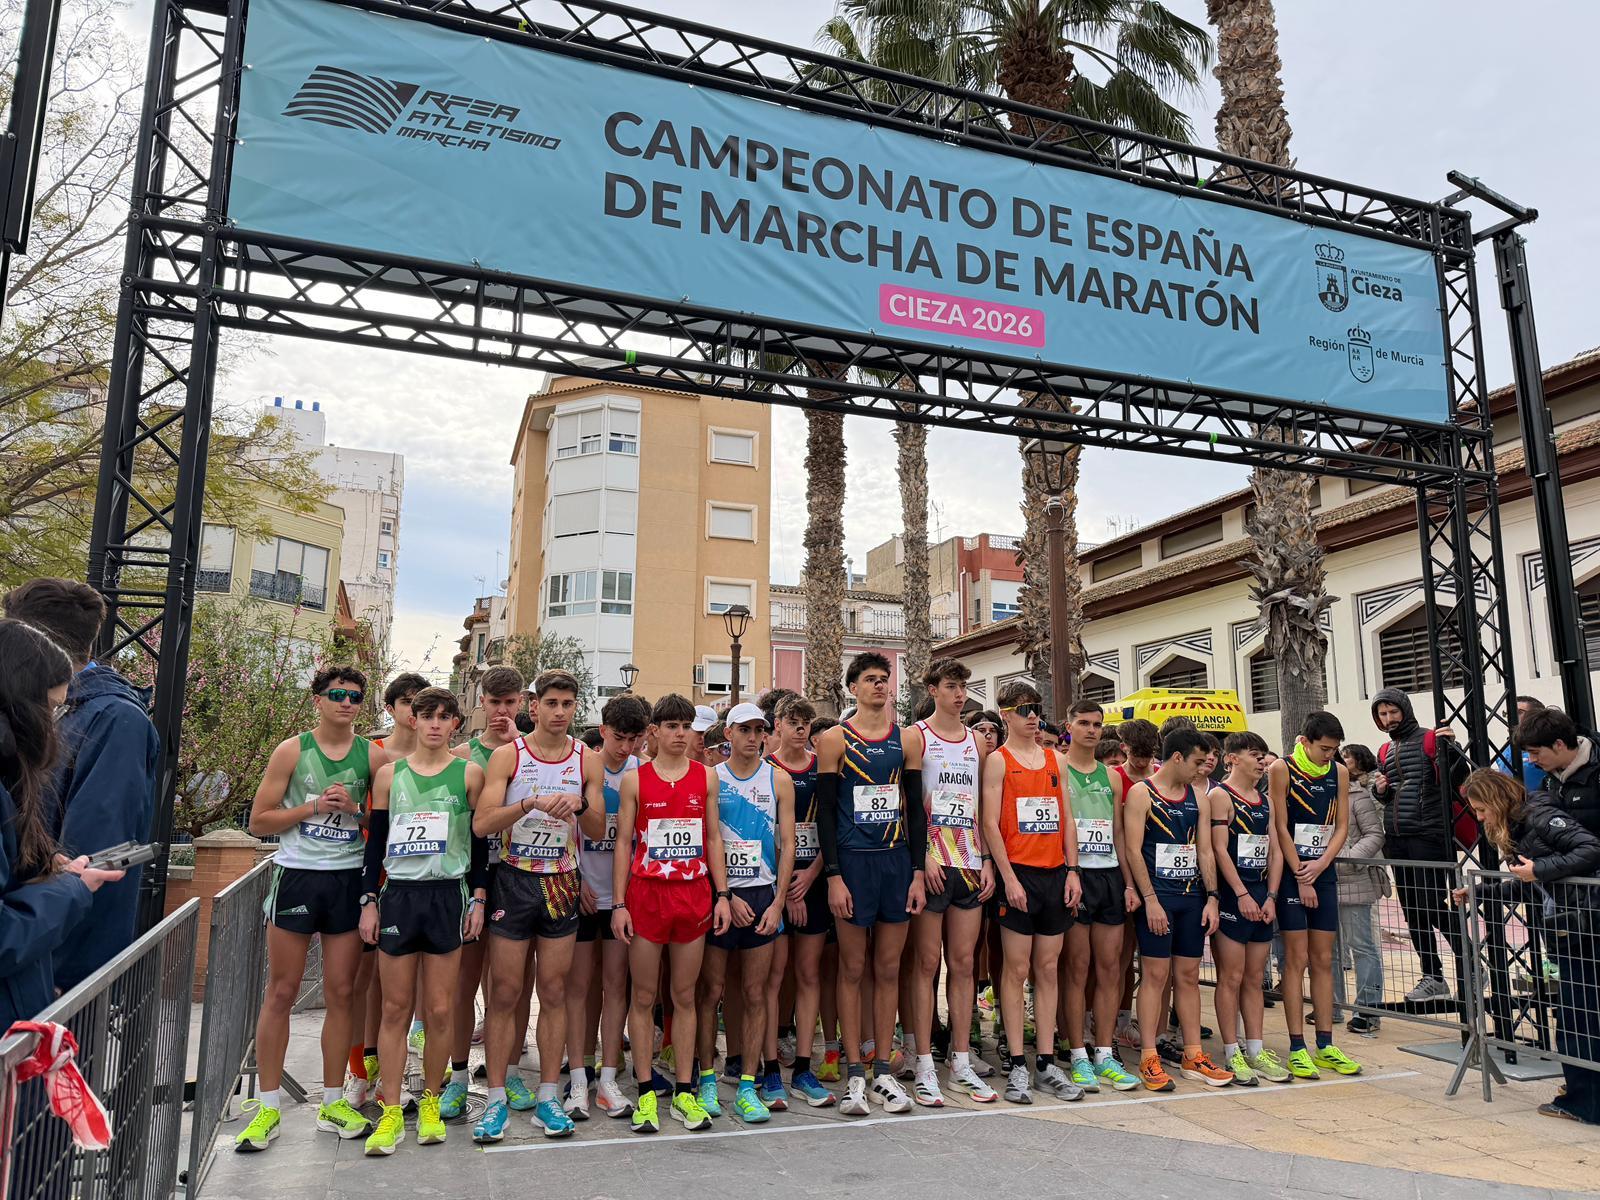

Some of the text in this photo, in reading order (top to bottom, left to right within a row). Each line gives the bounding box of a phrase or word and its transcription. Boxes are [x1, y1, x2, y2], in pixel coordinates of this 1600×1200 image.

[417, 90, 521, 123] RFEA
[406, 110, 562, 151] ATLETISMO
[396, 126, 491, 151] MARCHA
[604, 111, 1254, 282] CAMPEONATO DE ESPAÑA
[604, 171, 1260, 335] DE MARCHA DE MARATÓN
[1350, 268, 1393, 282] AYUNTAMIENTO
[1351, 276, 1403, 302] Cieza
[889, 293, 1033, 338] CIEZA 2026
[1309, 335, 1425, 366] Región de Murcia
[938, 770, 973, 787] ARAGÓN
[871, 797, 888, 811] 82
[949, 803, 965, 816] 75
[323, 812, 342, 828] 74
[1035, 808, 1051, 821] 95
[406, 825, 427, 841] 72
[531, 831, 552, 846] 77
[663, 831, 692, 846] 109
[1087, 830, 1103, 842] 70
[403, 841, 440, 855] Joma
[525, 846, 560, 857] Joma
[664, 847, 698, 858] Joma
[1254, 846, 1266, 858] 84
[724, 852, 748, 866] 105
[1173, 856, 1188, 868] 85
